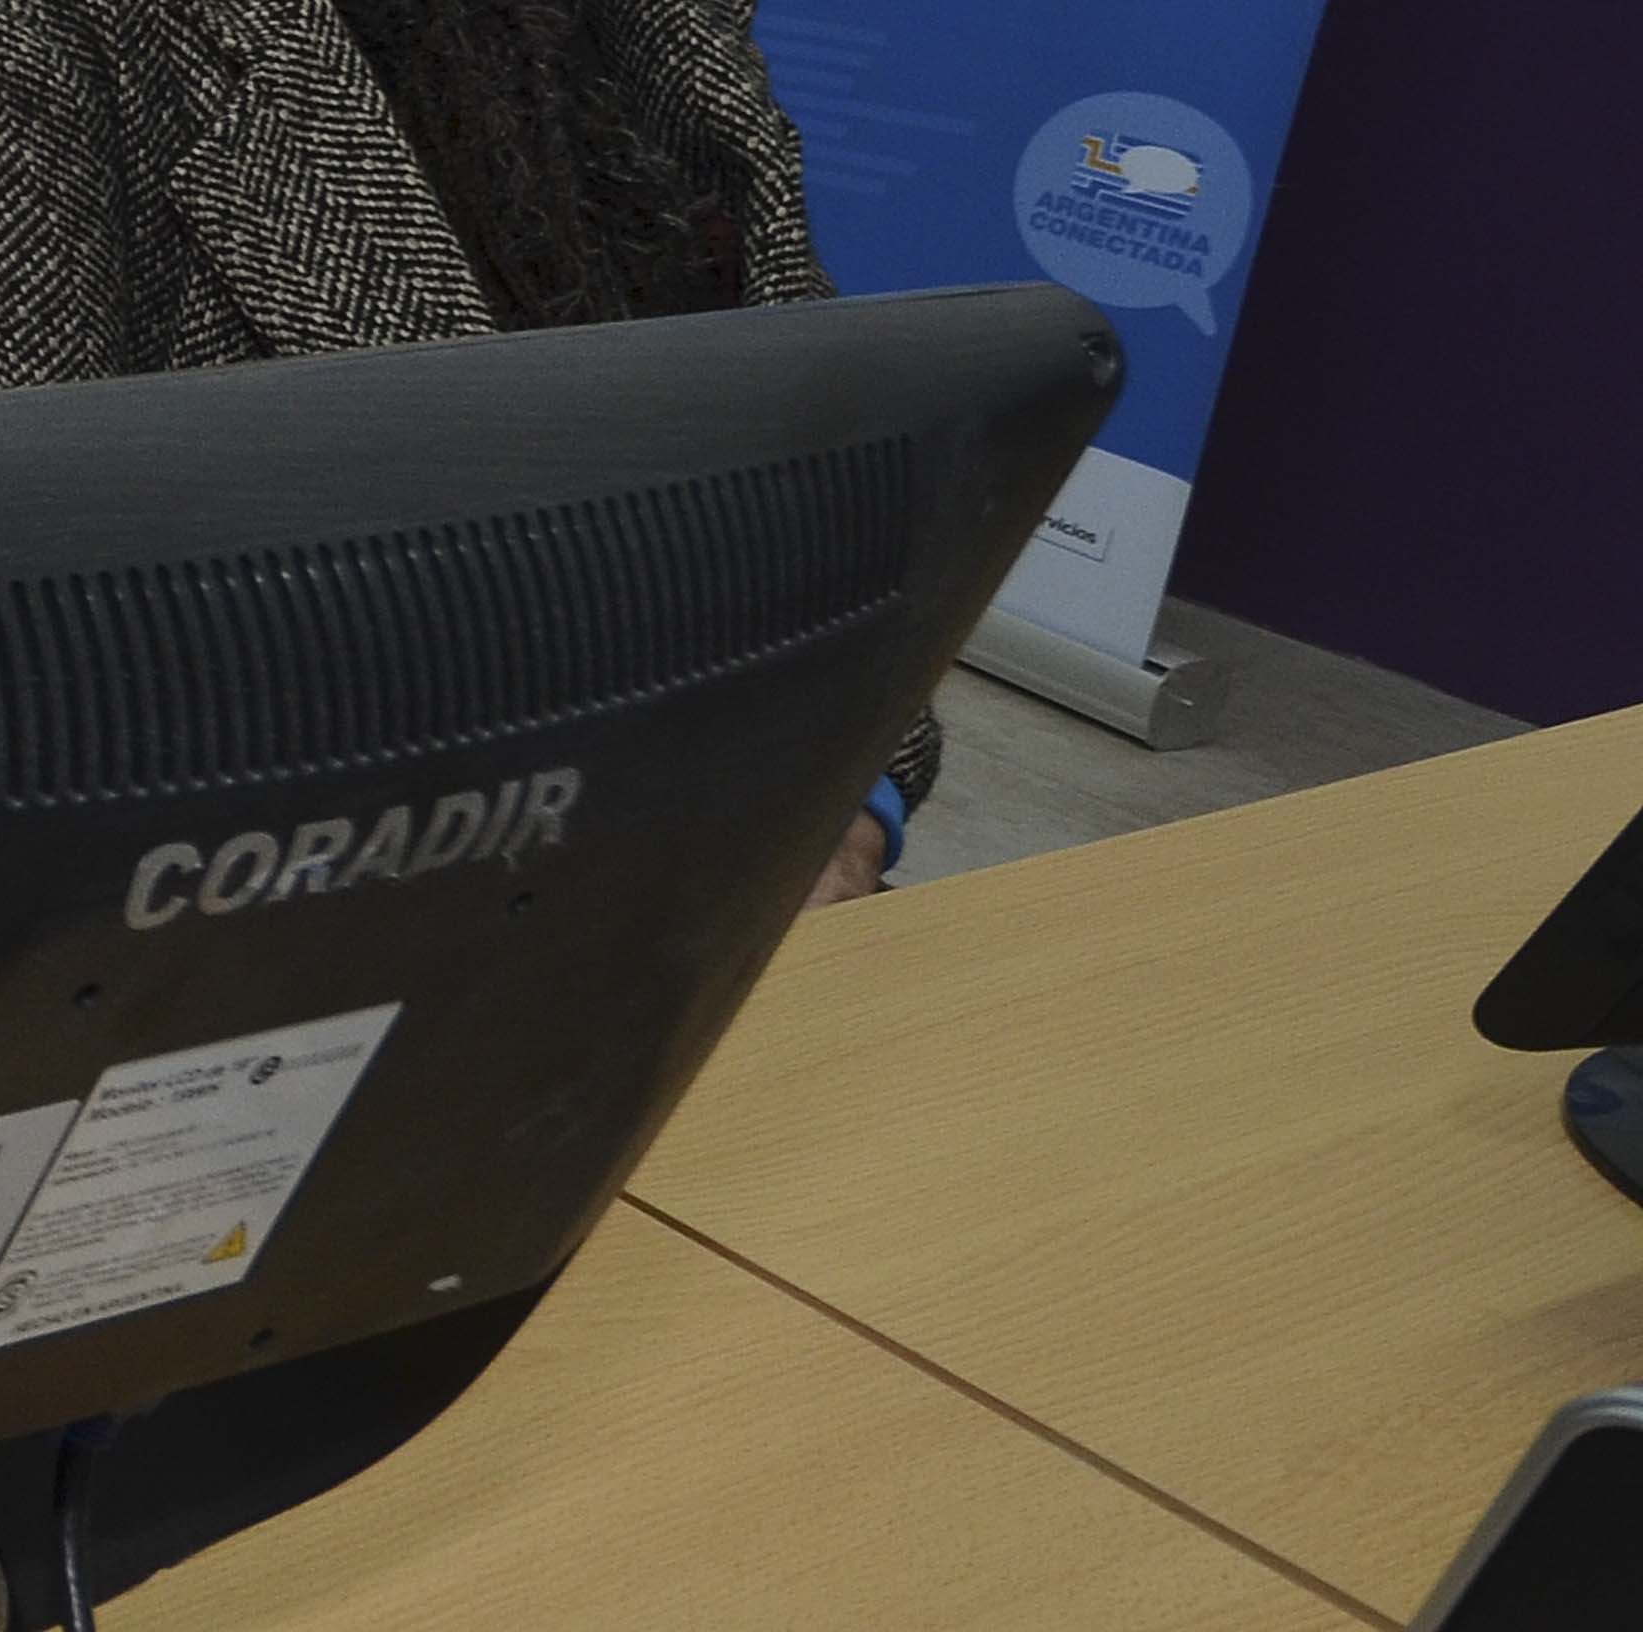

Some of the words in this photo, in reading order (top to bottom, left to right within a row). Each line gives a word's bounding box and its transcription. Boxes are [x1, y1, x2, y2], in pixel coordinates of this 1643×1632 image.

[1029, 211, 1203, 278] CONECTADA
[1034, 191, 1210, 257] ARGENTINA
[125, 766, 582, 932] CORADIR
